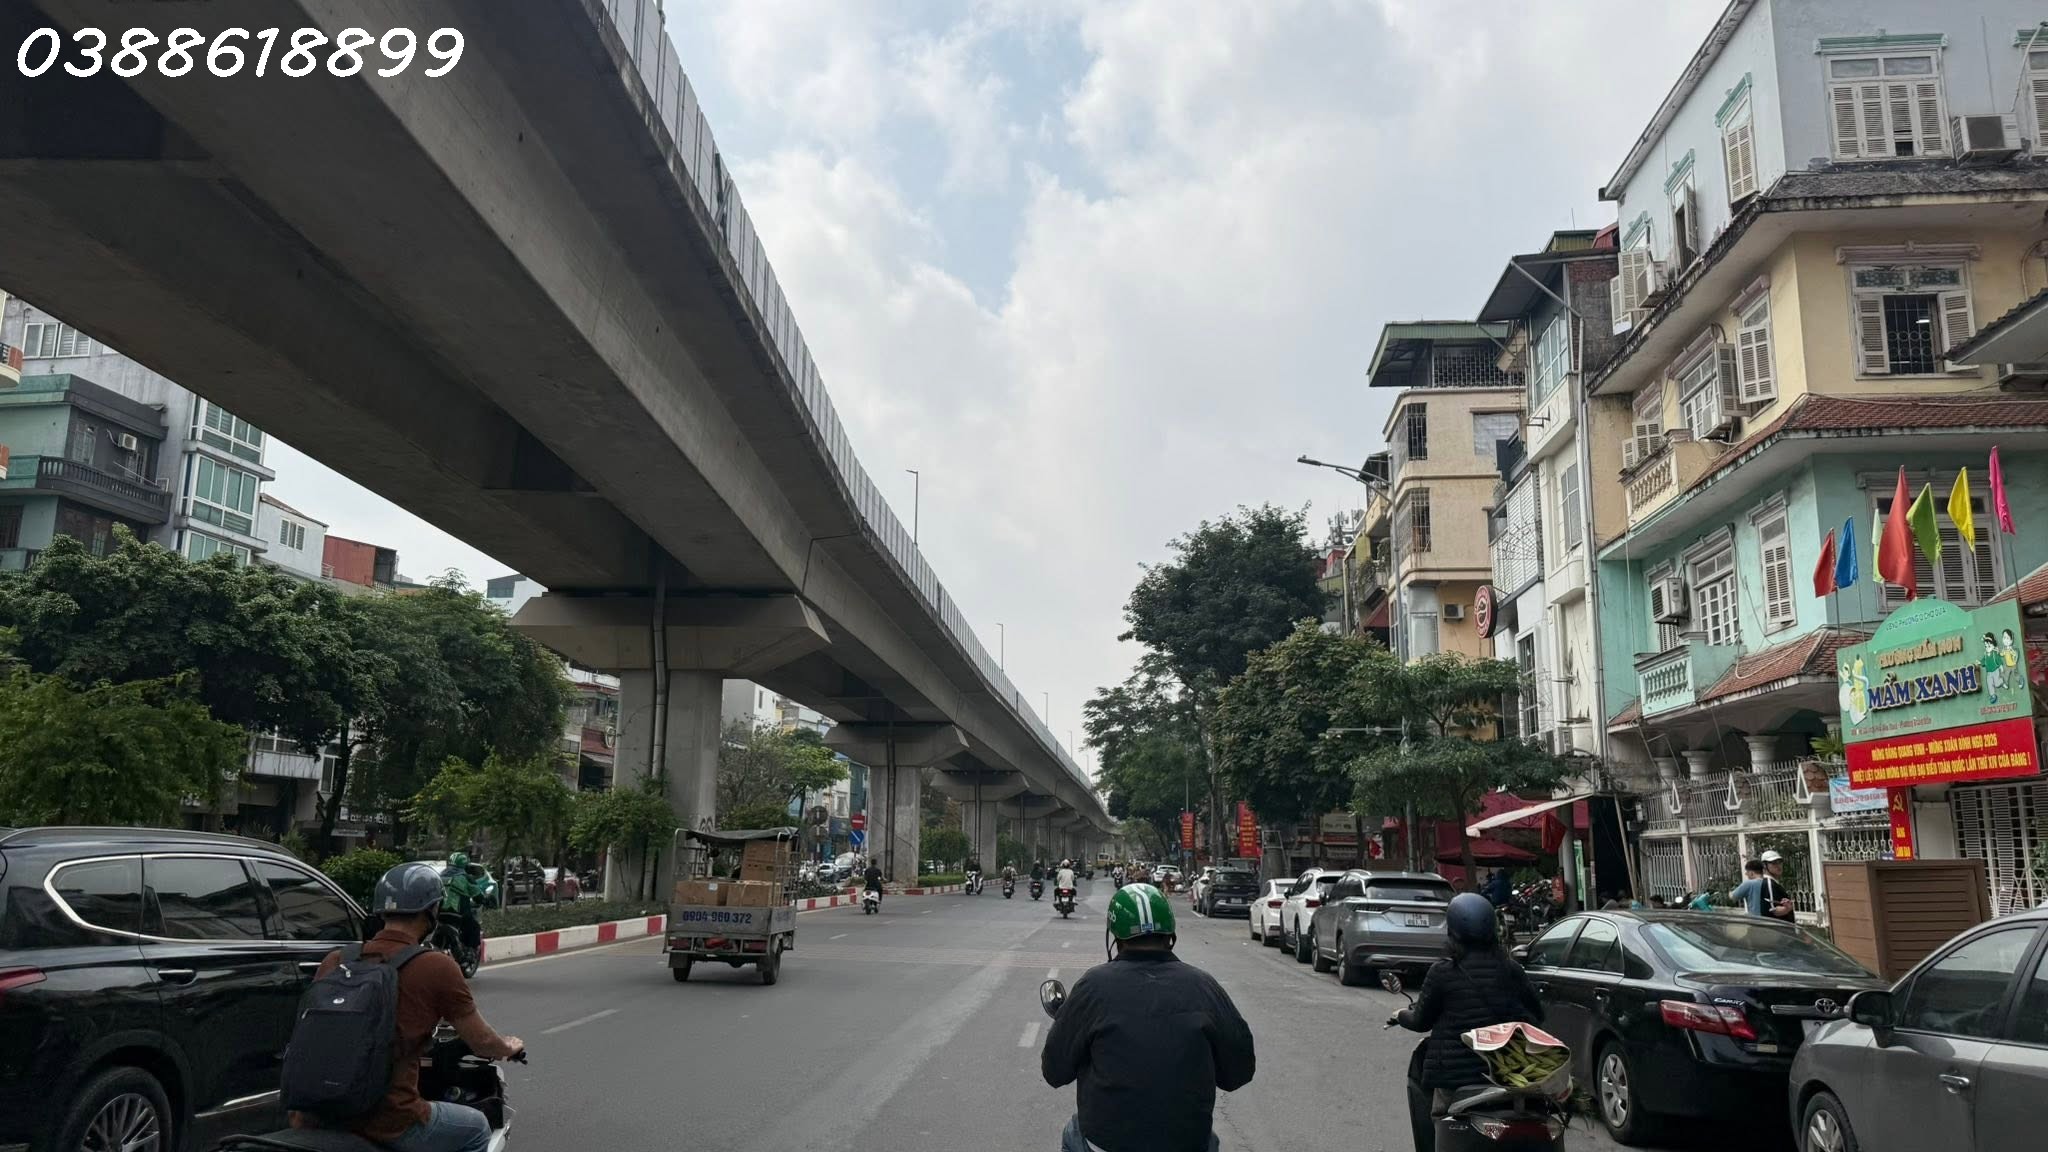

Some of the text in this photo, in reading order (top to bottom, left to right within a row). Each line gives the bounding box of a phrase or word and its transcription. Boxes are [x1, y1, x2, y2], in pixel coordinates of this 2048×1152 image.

[1868, 664, 1979, 709] MẦM XANH
[732, 912, 752, 924] 372
